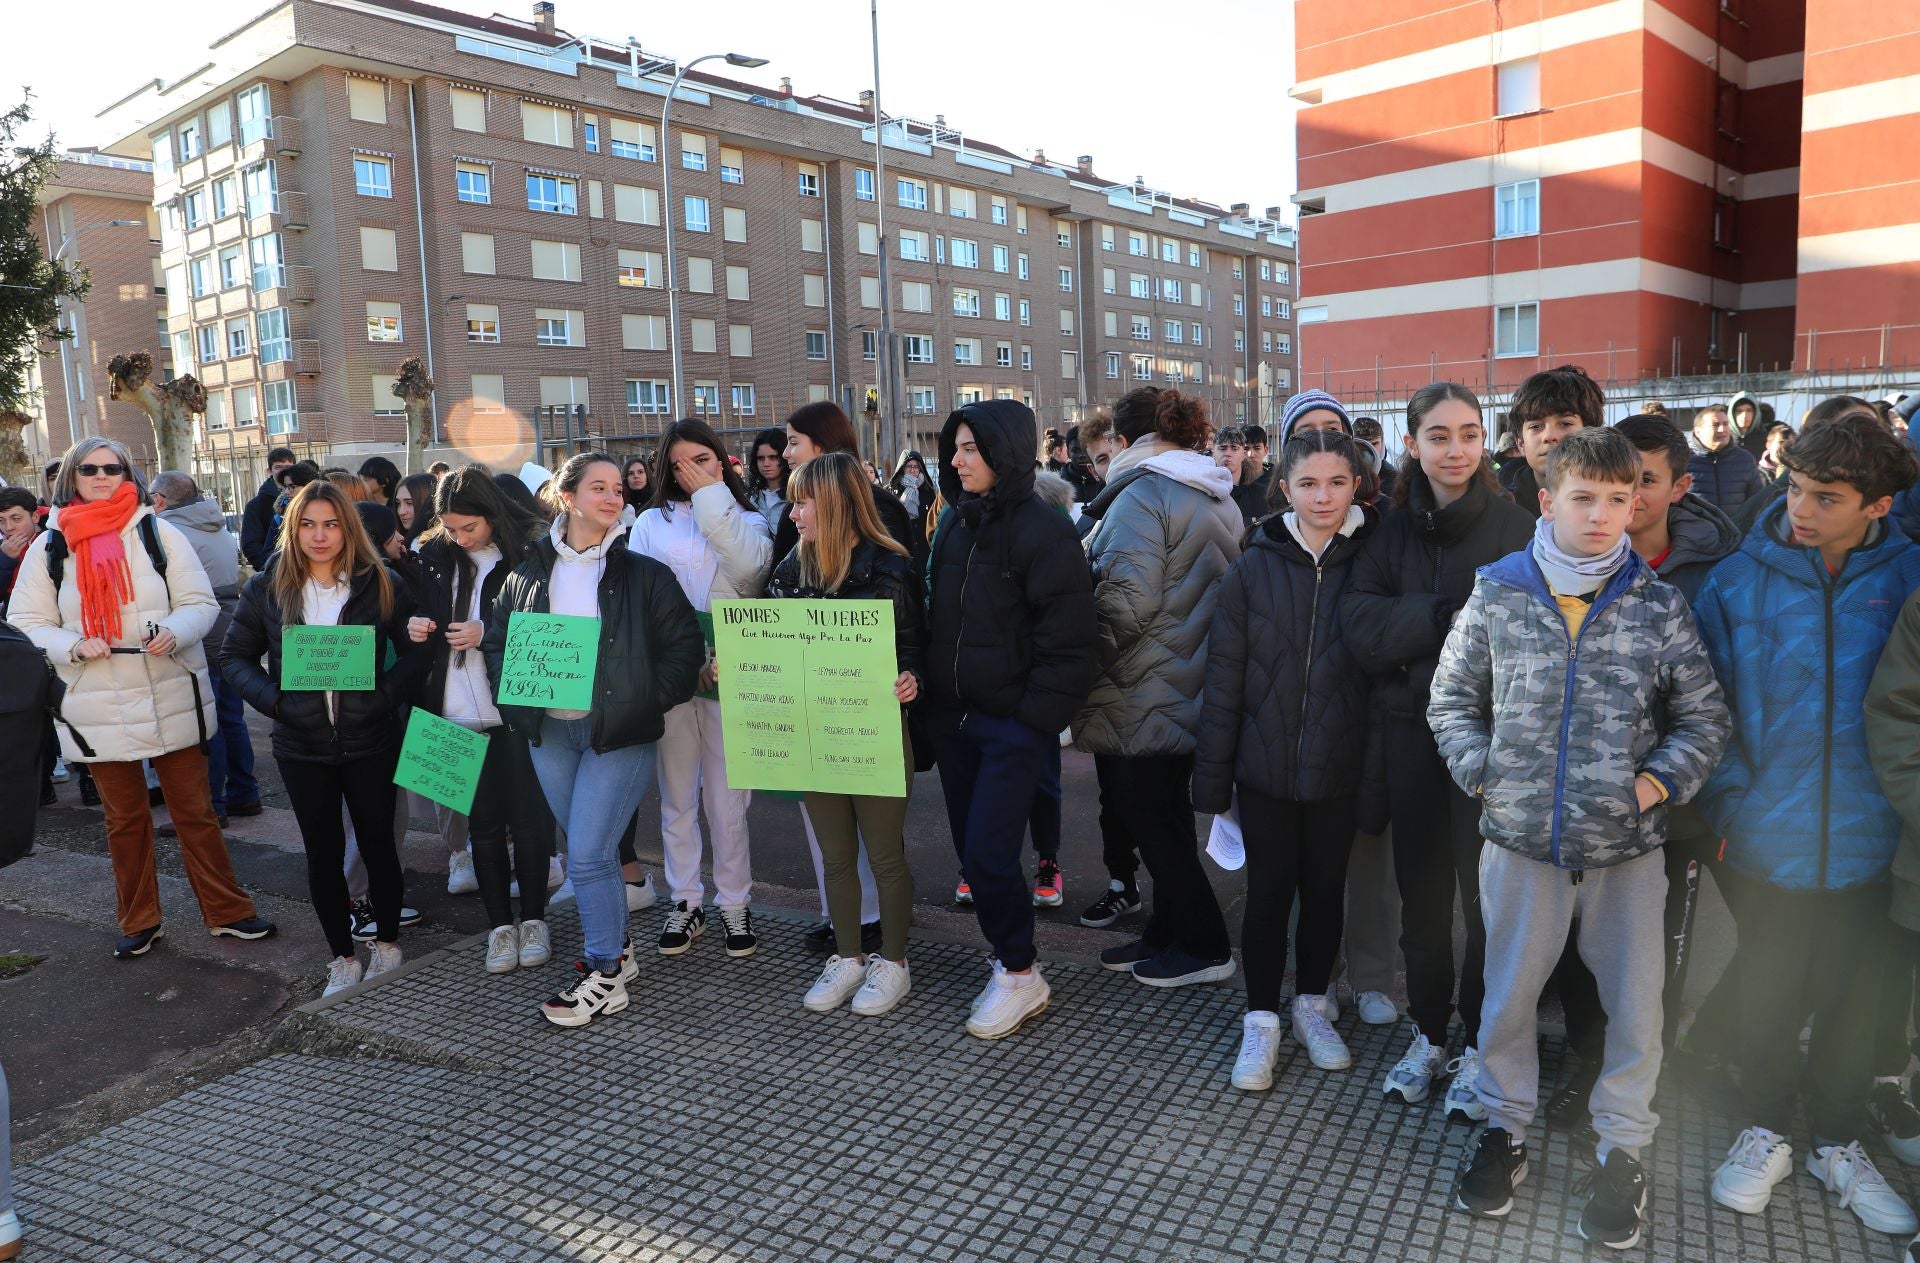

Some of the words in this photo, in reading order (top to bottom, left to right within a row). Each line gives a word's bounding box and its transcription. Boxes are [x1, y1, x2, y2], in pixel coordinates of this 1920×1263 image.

[723, 607, 780, 624] HOMRES
[806, 608, 879, 627] MUJERES
[741, 627, 757, 638] Que
[762, 629, 795, 640] Hicieron
[799, 632, 816, 645] Algo
[839, 633, 851, 642] La
[855, 633, 873, 643] Paz
